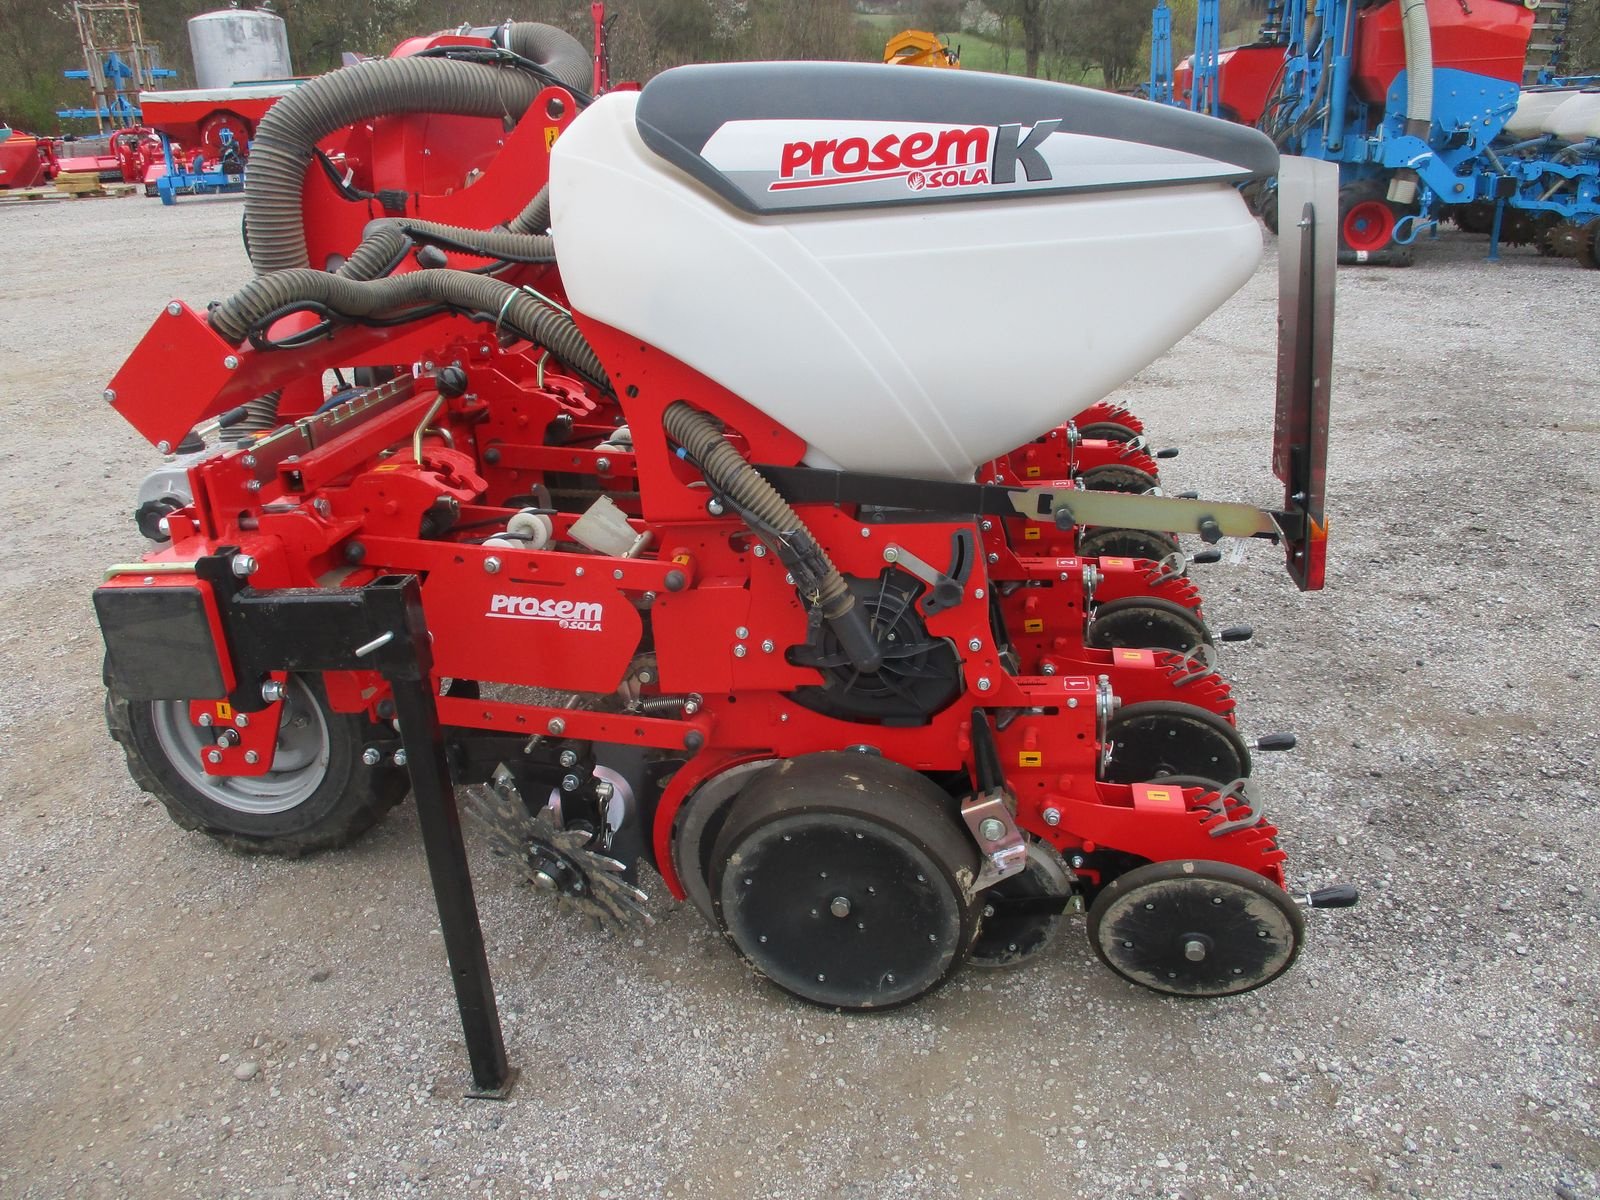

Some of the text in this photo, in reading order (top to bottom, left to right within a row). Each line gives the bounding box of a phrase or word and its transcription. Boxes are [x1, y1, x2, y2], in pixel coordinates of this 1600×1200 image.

[780, 118, 1063, 185] prosem K
[491, 594, 603, 621] prosem
[568, 621, 602, 632] SOLA
